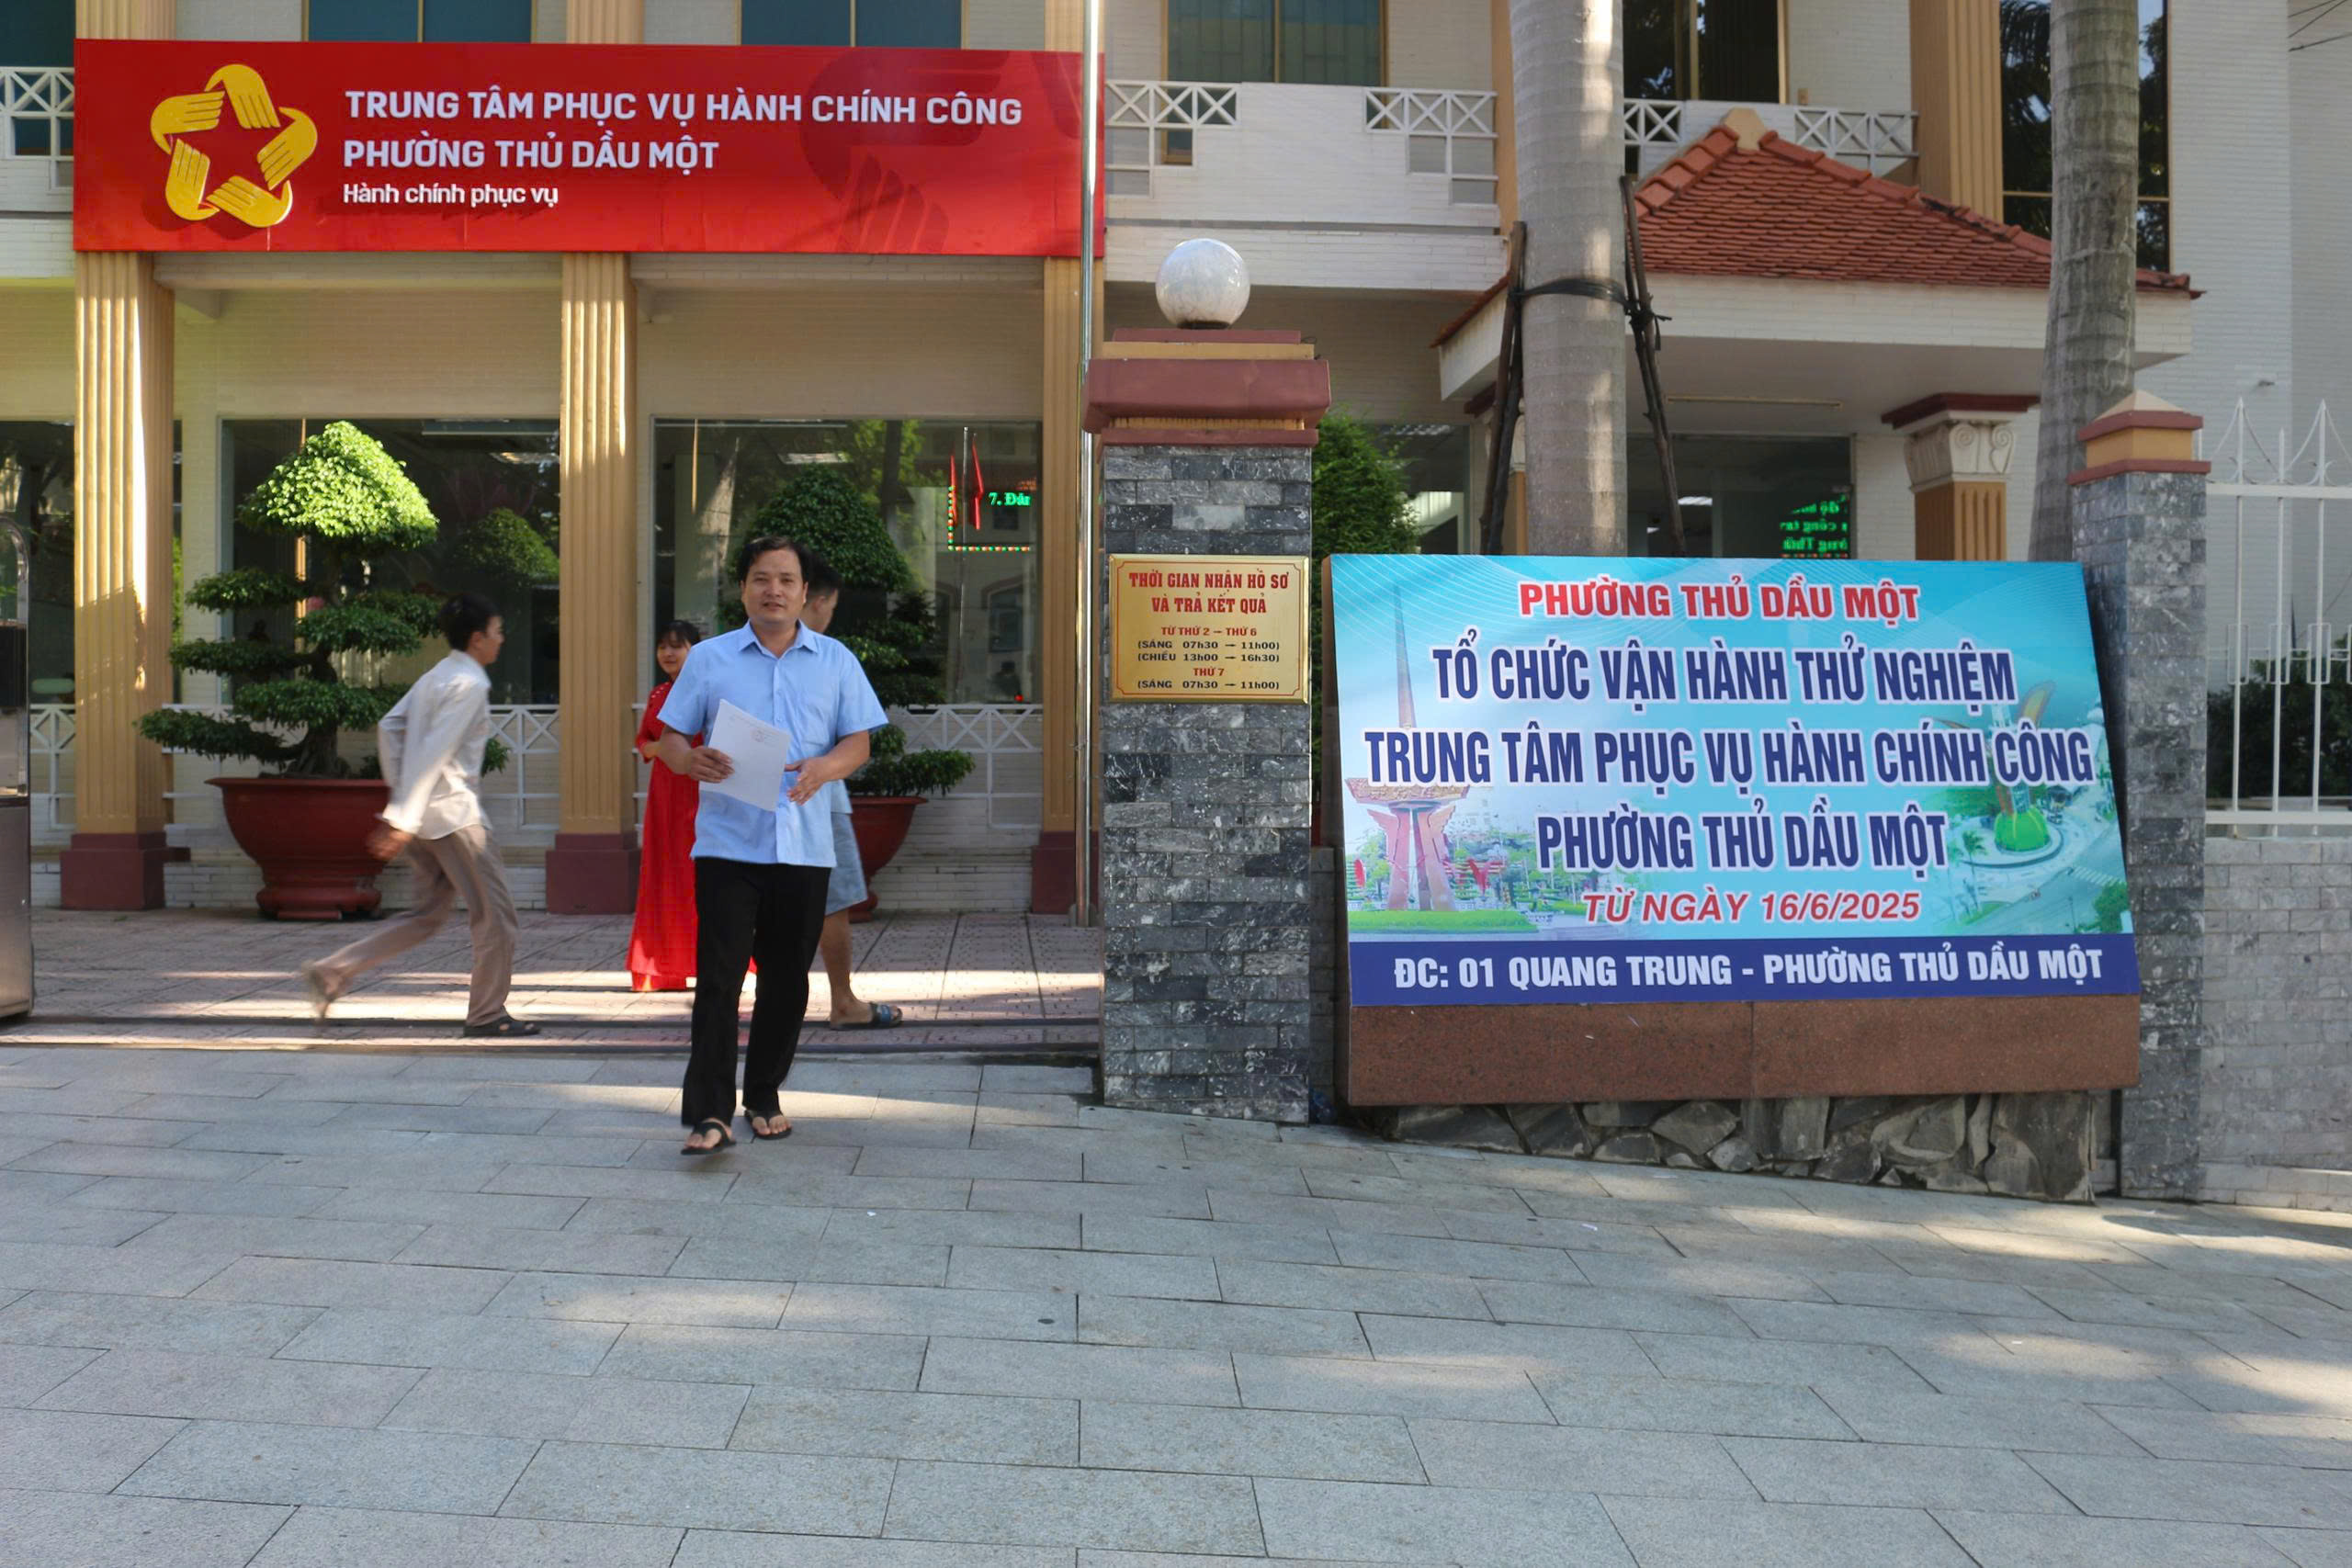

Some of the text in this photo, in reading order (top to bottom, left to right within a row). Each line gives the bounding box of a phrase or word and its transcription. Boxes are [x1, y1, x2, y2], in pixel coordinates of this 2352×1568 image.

[345, 85, 1022, 127] TRUNG TÂM PHỤC VỤ HÀNH CHÍNH CÔNG
[344, 130, 719, 175] PHƯỜNG THỦ DẦU MỘT
[344, 182, 559, 209] Hành chính phục vụ
[1128, 568, 1289, 592] THỜI GIAN NHẬN HỒ SƠ
[1151, 592, 1266, 614] VÀ TRẢ KẾT QUẢ
[1521, 575, 1919, 626] PHƯỜNG THỦ DẦU MỘT
[1137, 639, 1172, 649] (SÁNG
[1241, 642, 1279, 650] 11h00)
[1203, 627, 1209, 636] 2
[1240, 654, 1279, 662] 16h30)
[1432, 628, 2015, 712] TỔ CHỨC VẬN HÀNH THỬ NGHIỆM
[1137, 679, 1171, 688] (SÁNG
[1240, 682, 1279, 690] 11h00)
[1364, 721, 2093, 795] TRUNG TÂM PHỤC VỤ HÀNH CHÍNH CÔNG
[1538, 797, 1945, 878] PHƯỜNG THỦ DẦU MỘT
[1585, 886, 1919, 922] TỪ NGÀY 16/6/2025
[1394, 957, 1449, 988] ĐC:
[1459, 957, 1494, 988] 01
[1509, 955, 1617, 991] QUANG
[1625, 954, 1732, 986] TRUNG
[1763, 946, 1893, 984] PHƯỜNG
[1899, 942, 1959, 982] THỦ
[1967, 941, 2030, 981] DẦU
[2038, 943, 2102, 986] MỘT
